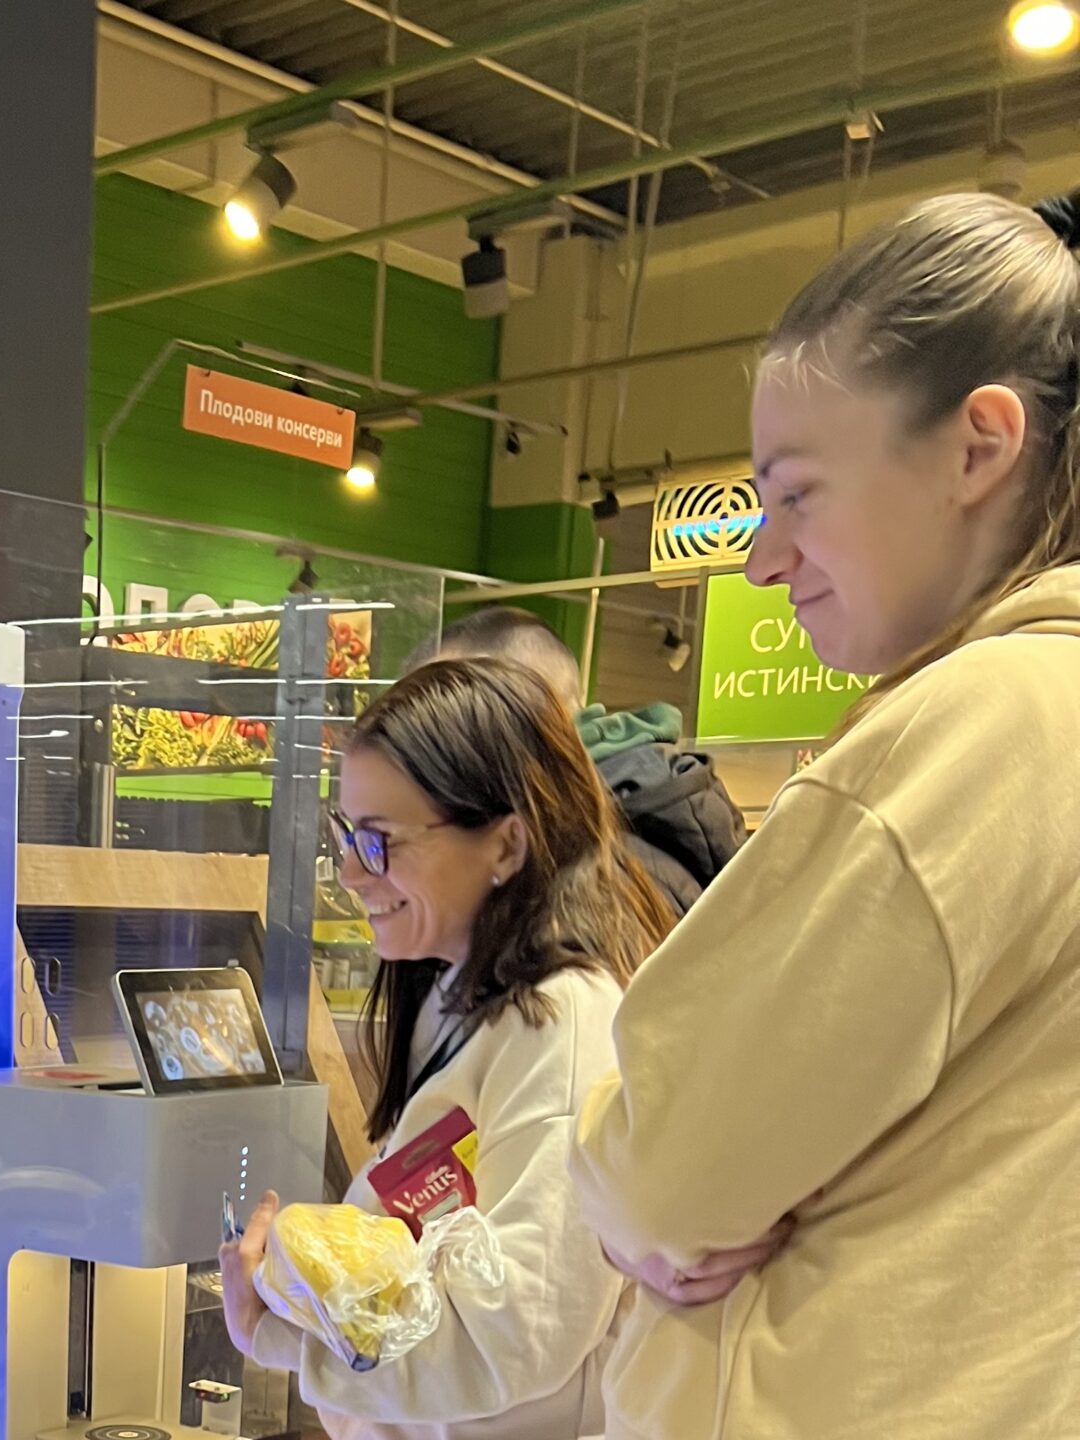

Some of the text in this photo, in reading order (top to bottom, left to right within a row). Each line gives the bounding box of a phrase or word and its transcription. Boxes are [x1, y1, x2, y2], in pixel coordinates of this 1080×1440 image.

[199, 389, 343, 449] Плодови консерви
[393, 1171, 458, 1215] Venus
